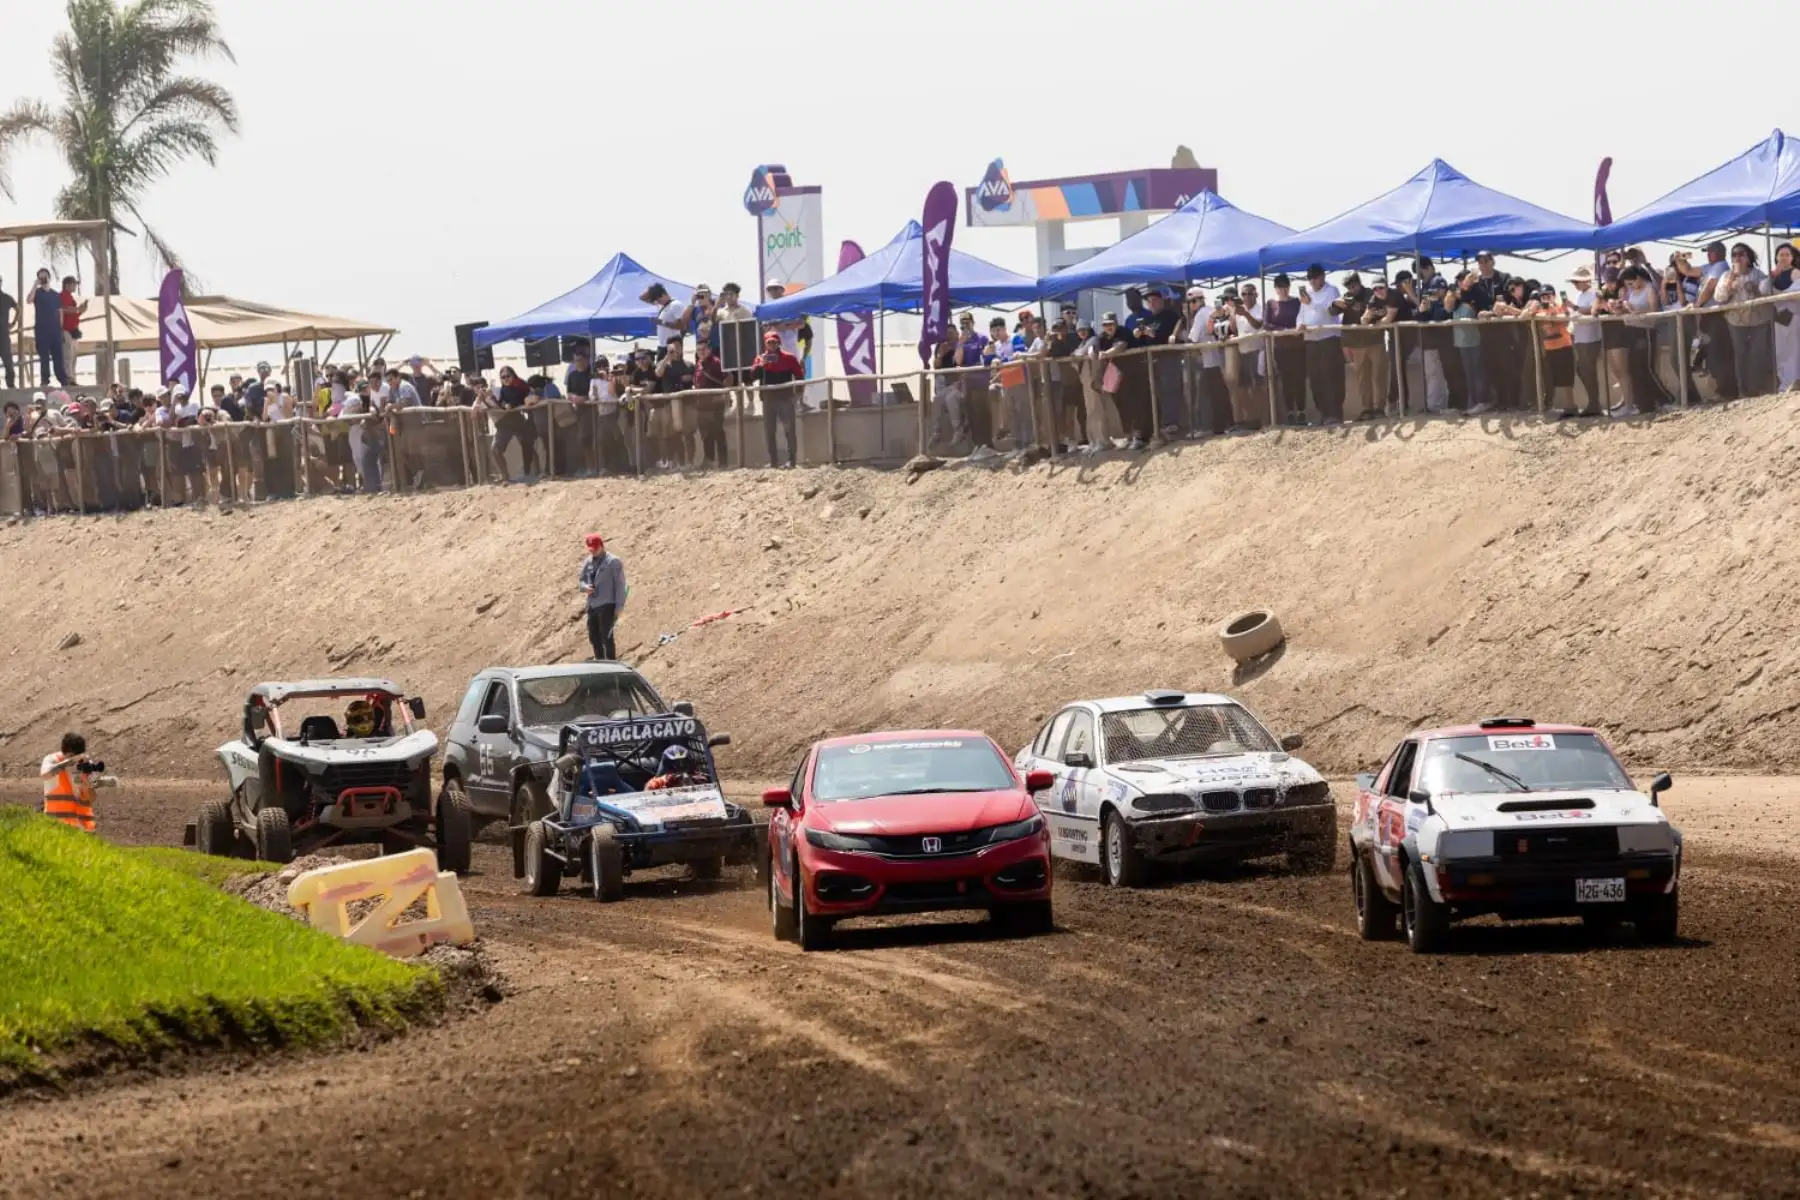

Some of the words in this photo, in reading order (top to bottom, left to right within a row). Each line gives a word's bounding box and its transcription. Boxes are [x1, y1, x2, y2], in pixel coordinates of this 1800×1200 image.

[746, 186, 773, 202] AVA
[979, 180, 1009, 197] AVA
[767, 224, 803, 257] point
[1578, 883, 1624, 899] H2G-436
